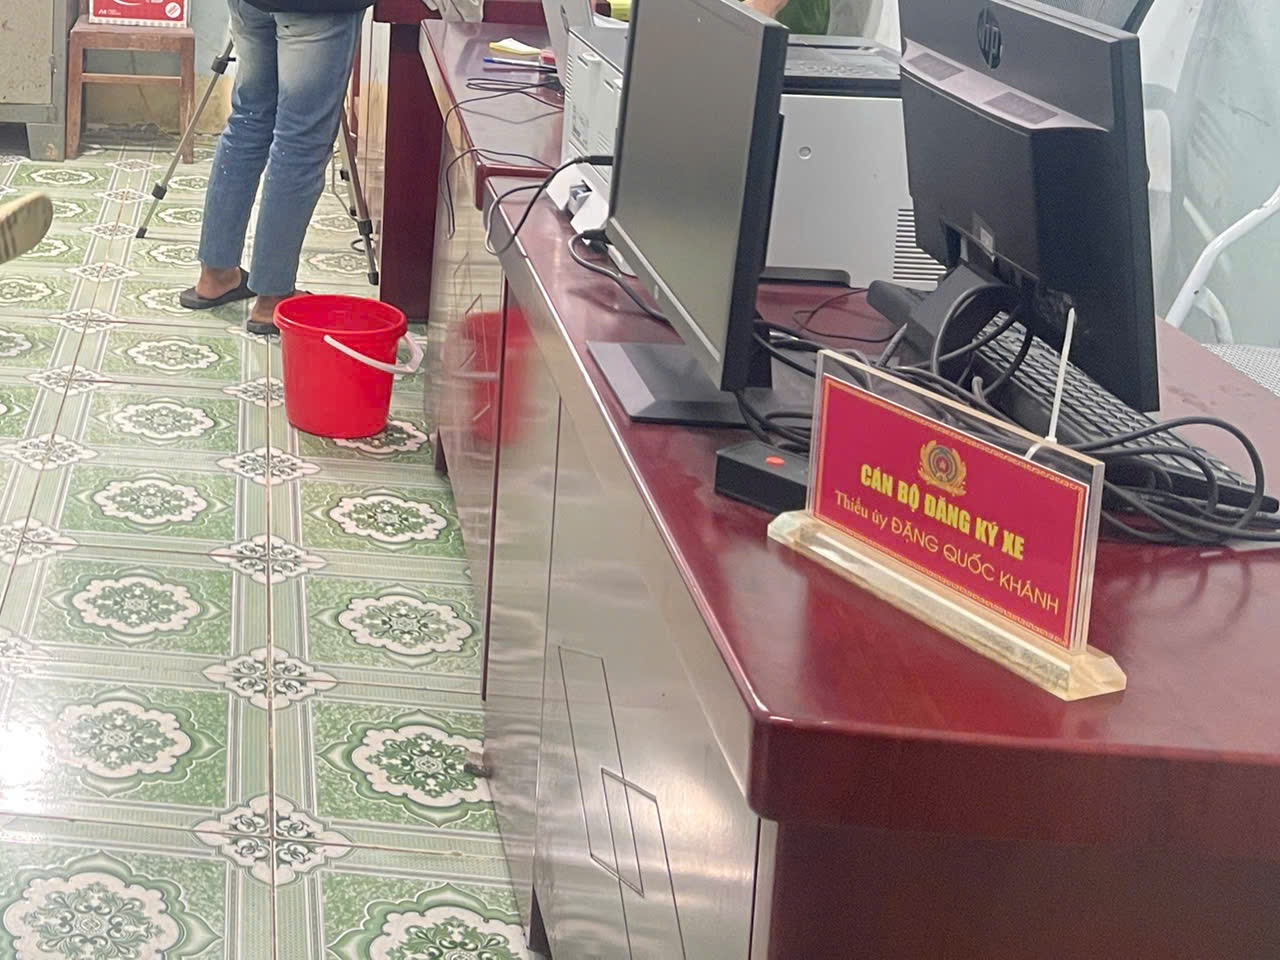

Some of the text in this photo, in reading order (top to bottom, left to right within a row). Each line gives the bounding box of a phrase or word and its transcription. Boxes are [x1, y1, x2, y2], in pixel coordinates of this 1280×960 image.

[860, 463, 1025, 561] CÁN BỘ ĐĂNG KÝ XE
[890, 516, 939, 552] ĐẶNG
[943, 543, 995, 581] QUỐC
[999, 570, 1060, 615] KHÁNH
